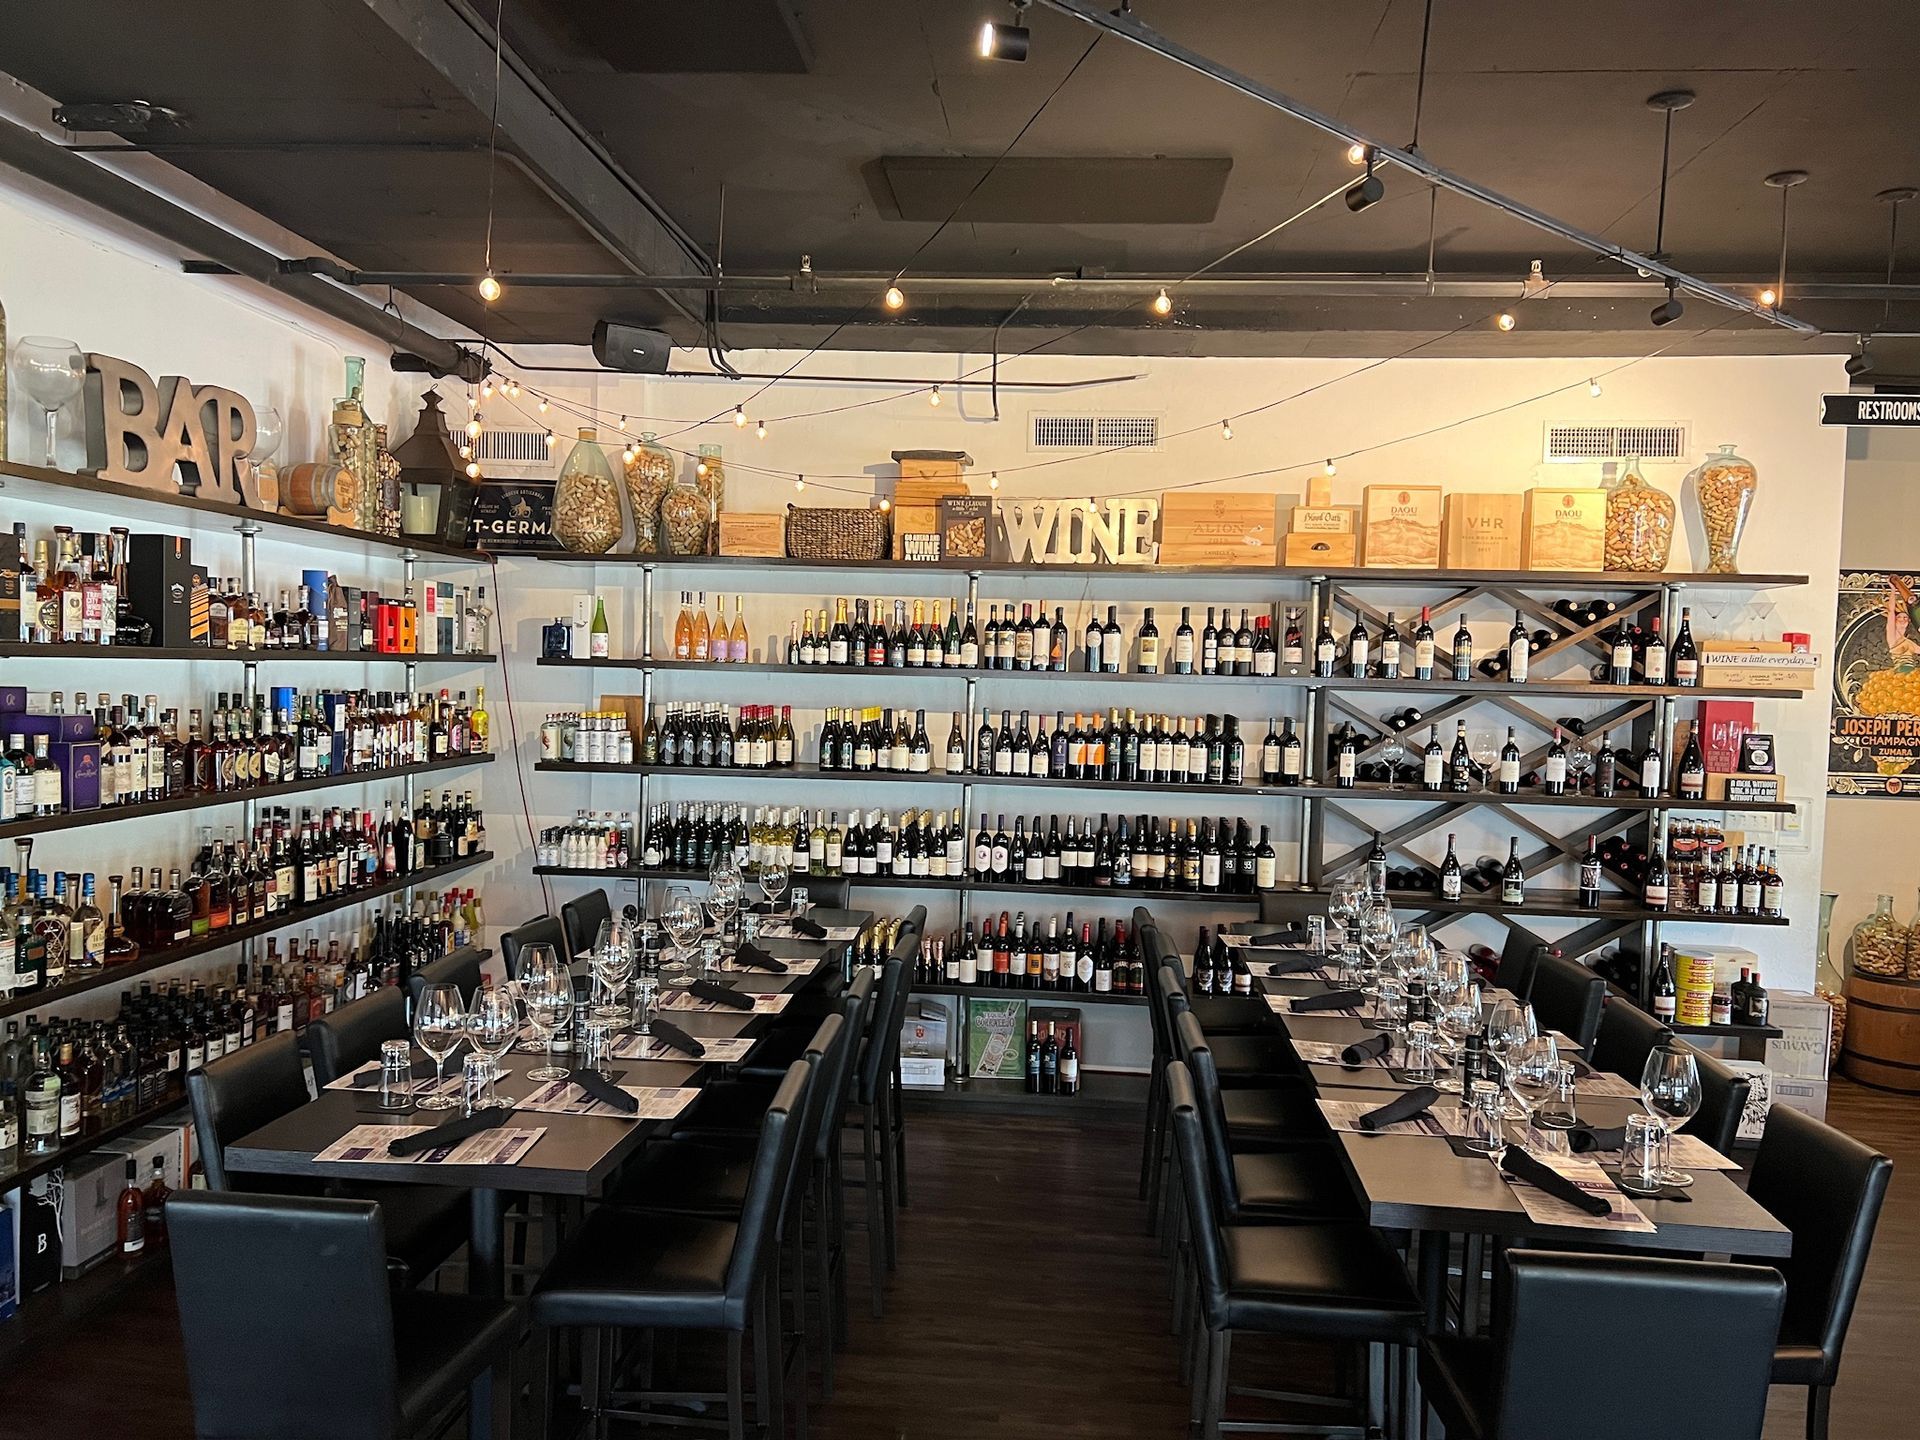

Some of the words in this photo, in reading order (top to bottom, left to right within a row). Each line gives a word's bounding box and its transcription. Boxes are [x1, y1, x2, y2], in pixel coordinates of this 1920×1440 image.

[84, 352, 262, 510] BAR
[1391, 506, 1418, 514] DAOU
[1555, 509, 1582, 518] DAOU
[1193, 524, 1244, 533] ALION
[1467, 517, 1504, 529] VHR
[997, 497, 1158, 563] WINE
[904, 541, 940, 555] WINE
[1711, 654, 1740, 664] WINE
[1748, 654, 1767, 664] little
[1840, 719, 1891, 735] JOSEPH
[1772, 1040, 1824, 1054] CAYMUS
